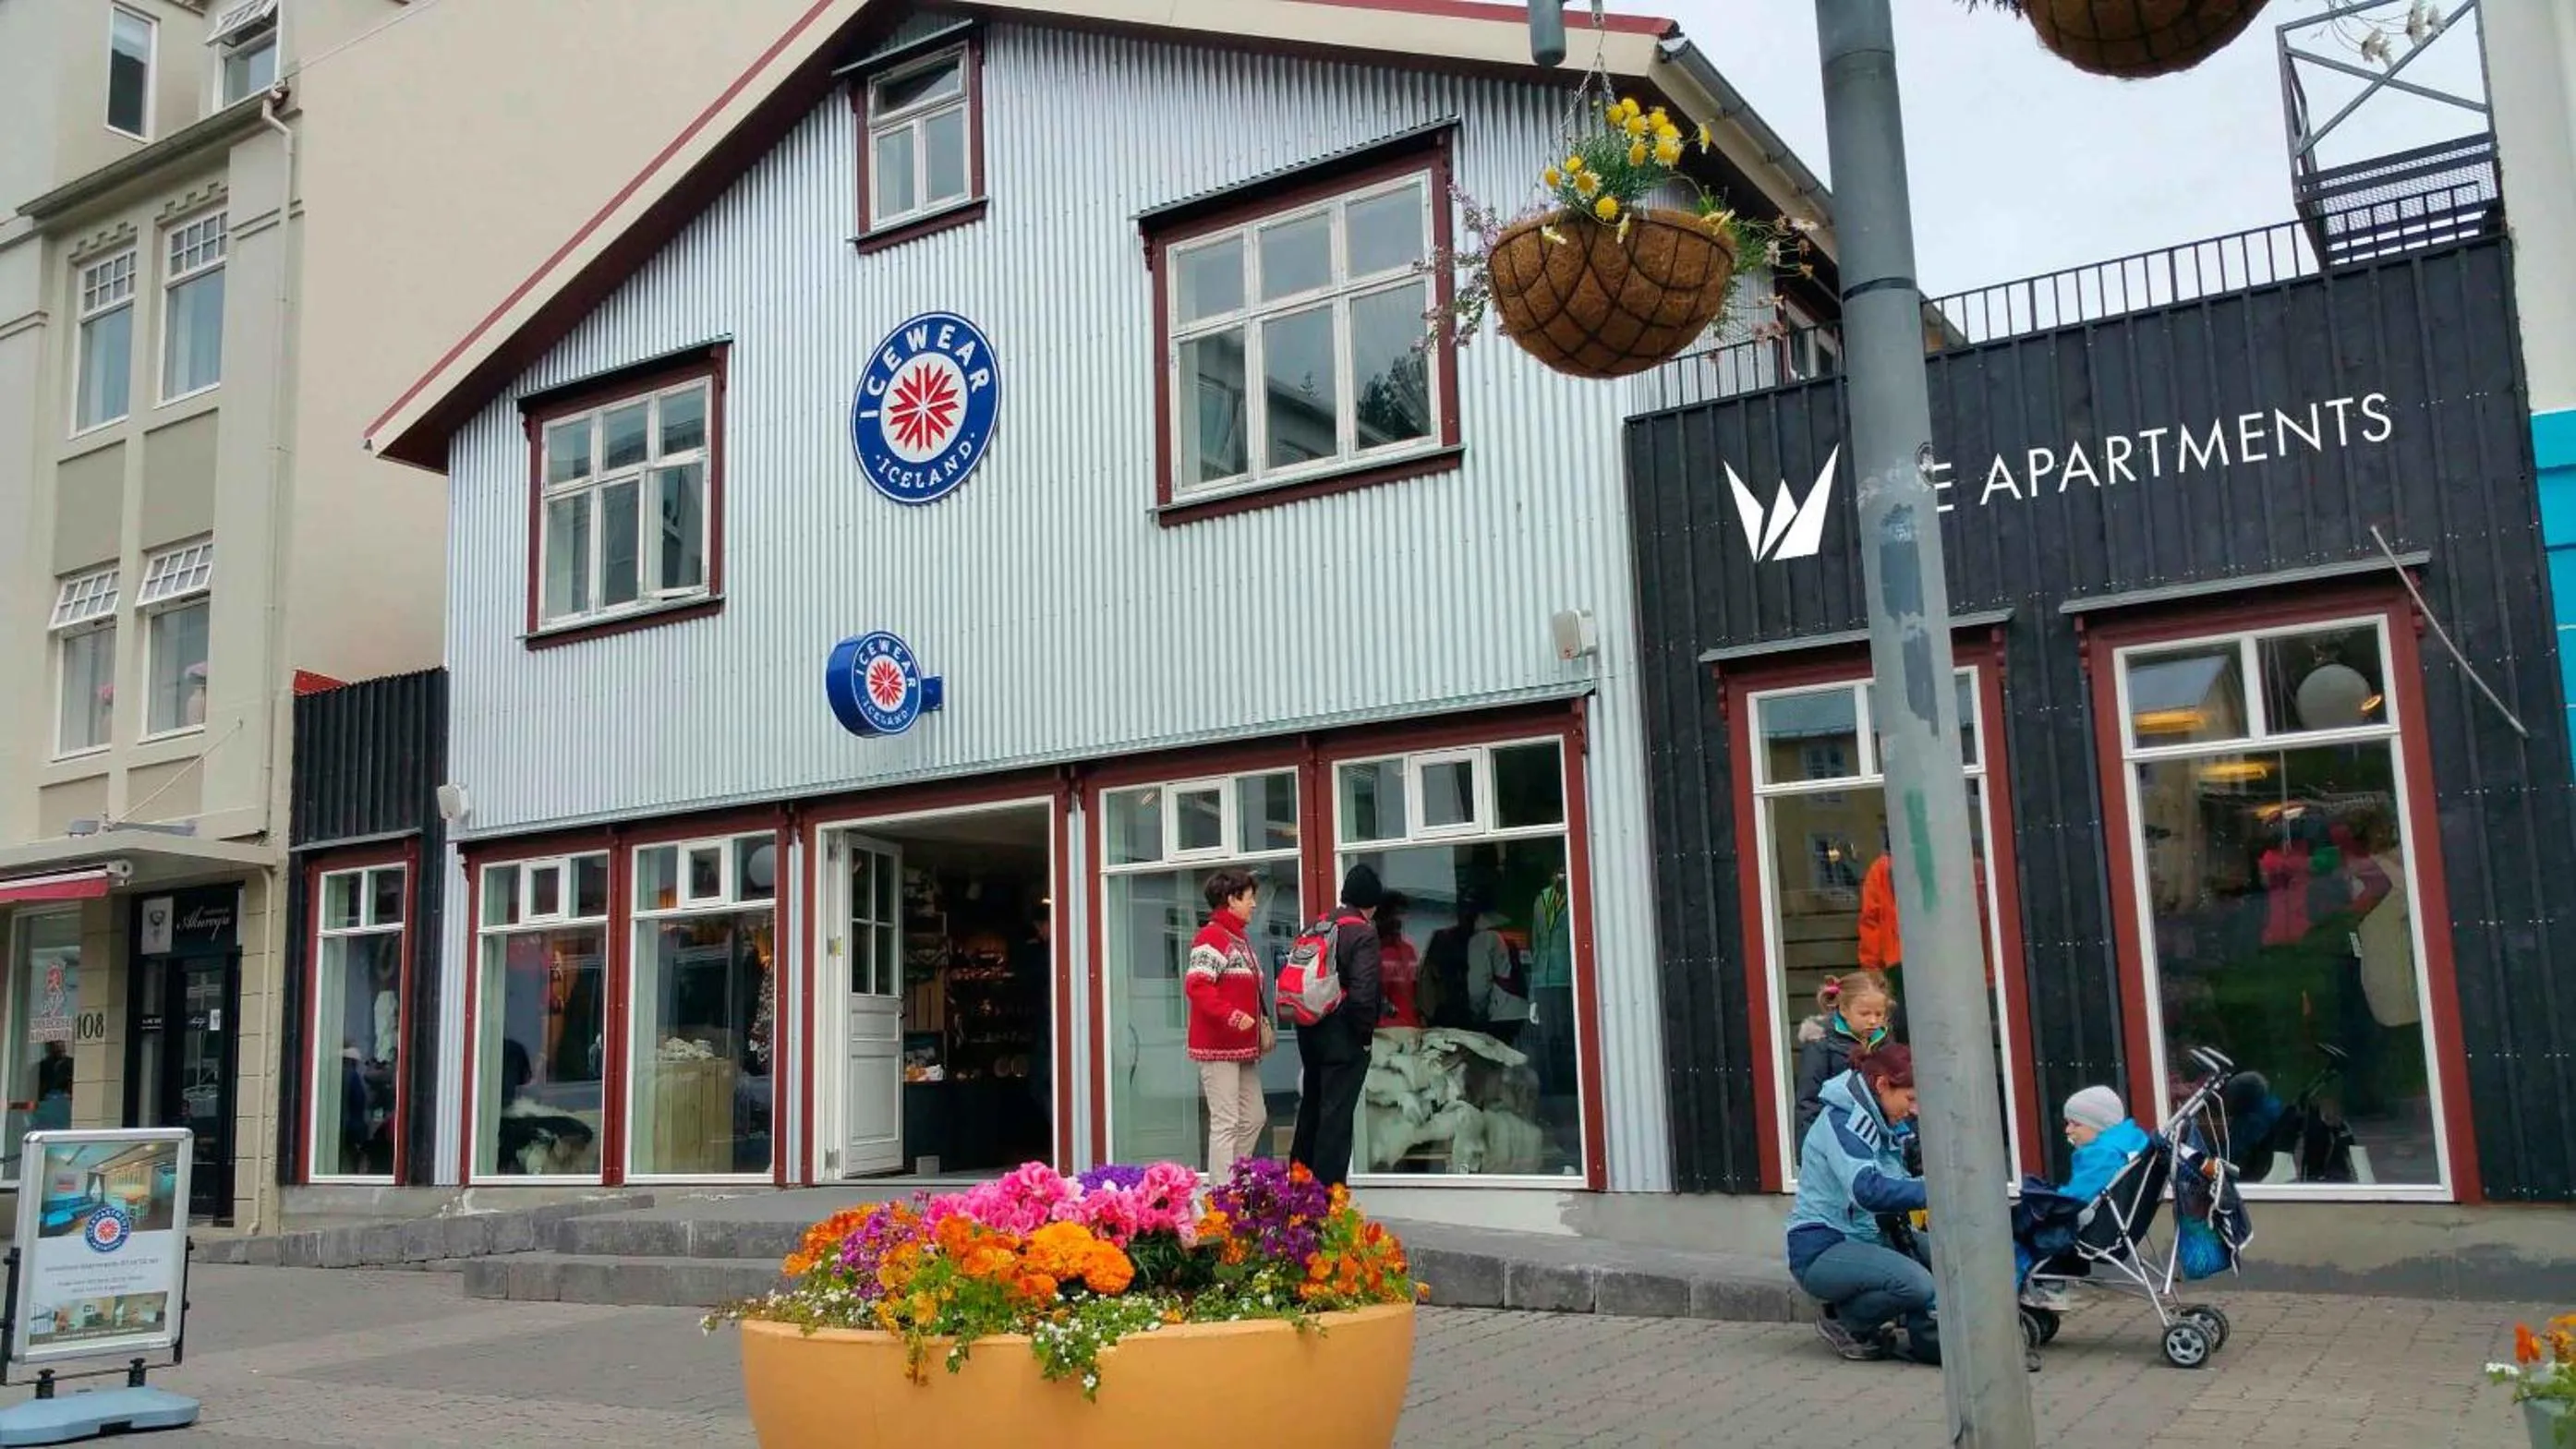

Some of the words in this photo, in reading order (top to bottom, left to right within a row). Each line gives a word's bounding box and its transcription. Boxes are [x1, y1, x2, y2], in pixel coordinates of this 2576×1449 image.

[860, 323, 990, 418] ICEWEAR
[877, 440, 973, 489] ICELAND
[1979, 392, 2392, 505] APARTMENTS
[855, 638, 916, 688] ICEWEAR
[863, 699, 909, 726] ICELAND
[76, 1012, 104, 1040] 108
